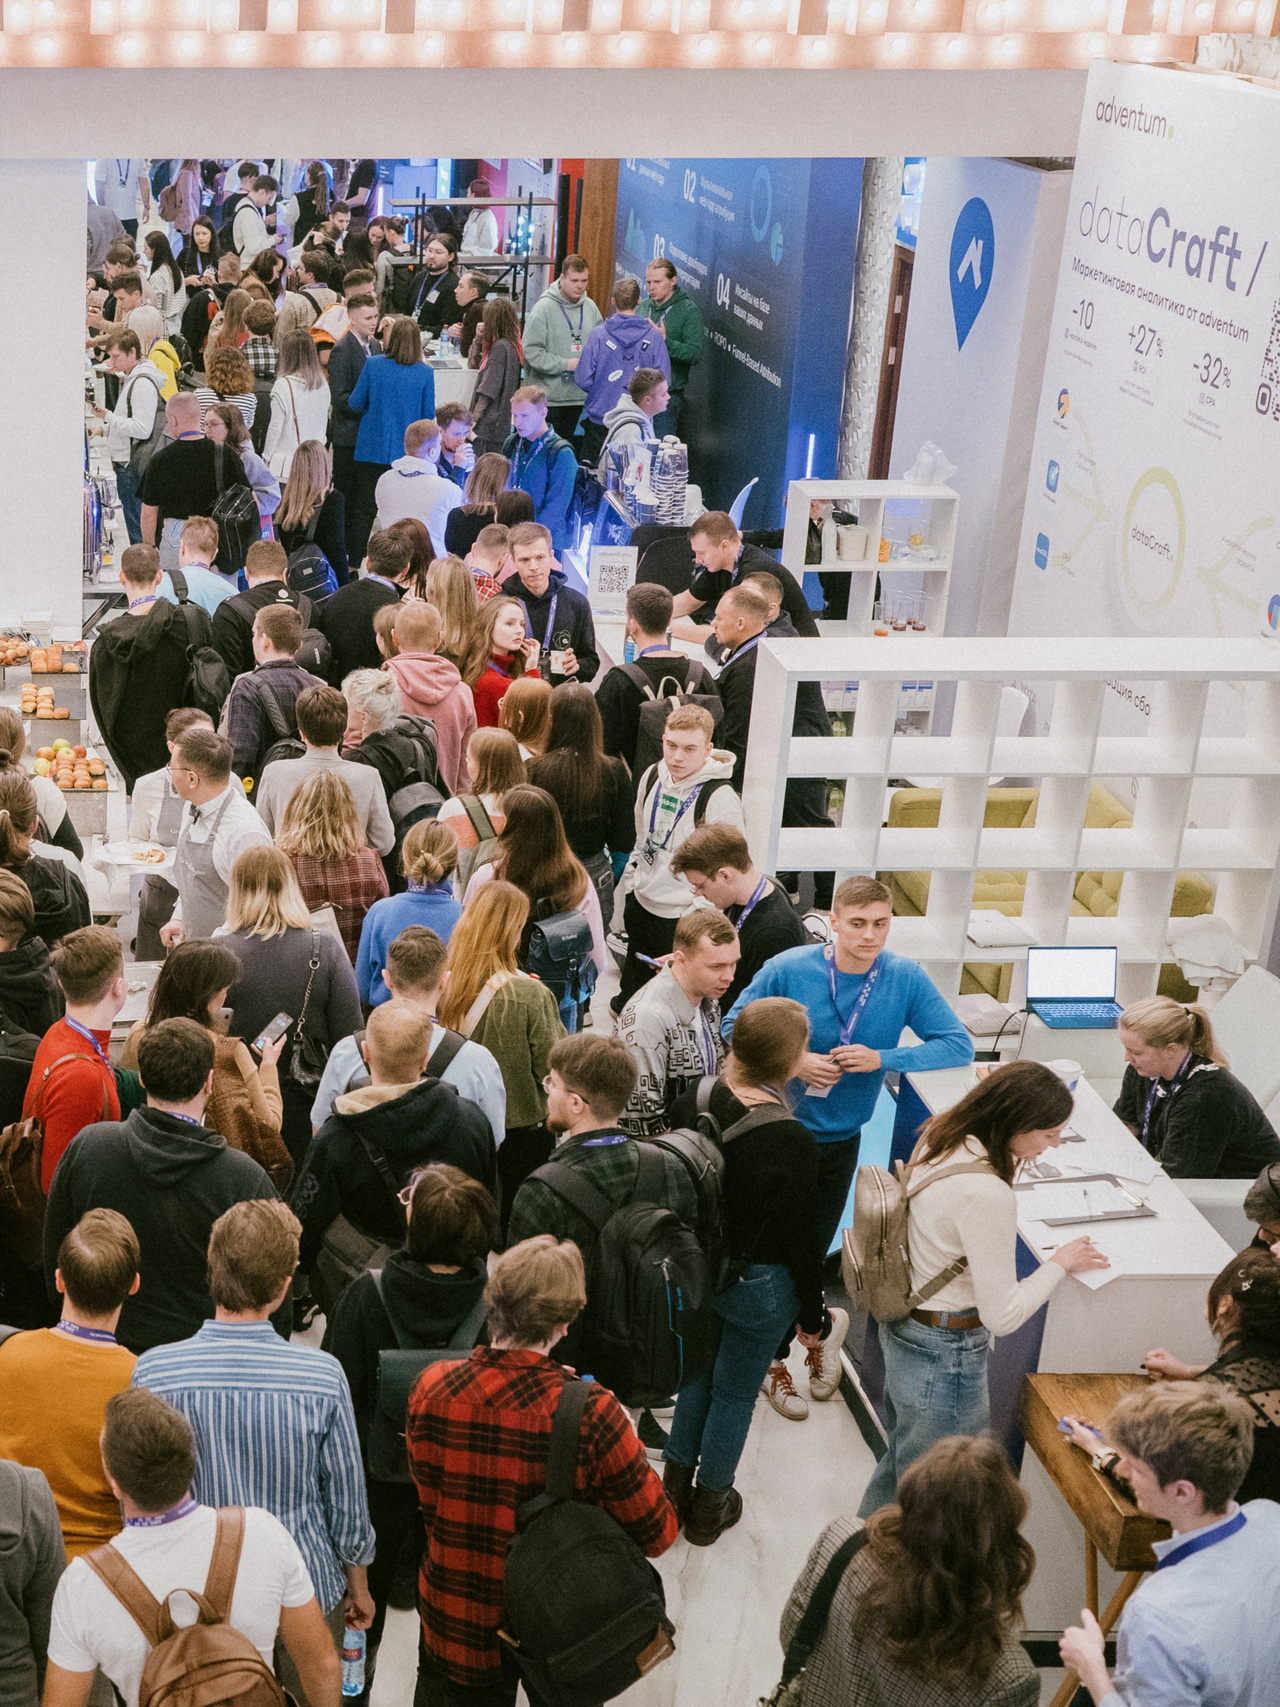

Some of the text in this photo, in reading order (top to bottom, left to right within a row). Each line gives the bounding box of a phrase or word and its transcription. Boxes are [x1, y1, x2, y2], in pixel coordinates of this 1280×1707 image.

[683, 168, 697, 204] 02
[653, 233, 666, 259] 03
[1079, 185, 1242, 292] dataCraft
[716, 272, 731, 310] 04
[734, 283, 753, 305] Инсайты
[759, 297, 771, 315] базе
[1071, 257, 1249, 342] Маркетинговая аналитика от adventum
[746, 312, 764, 331] данных
[1072, 299, 1095, 330] -10
[1128, 324, 1164, 358] +27%
[732, 344, 760, 374] Funnel-Based
[759, 363, 782, 388] Attribution
[1193, 352, 1232, 389] -32%
